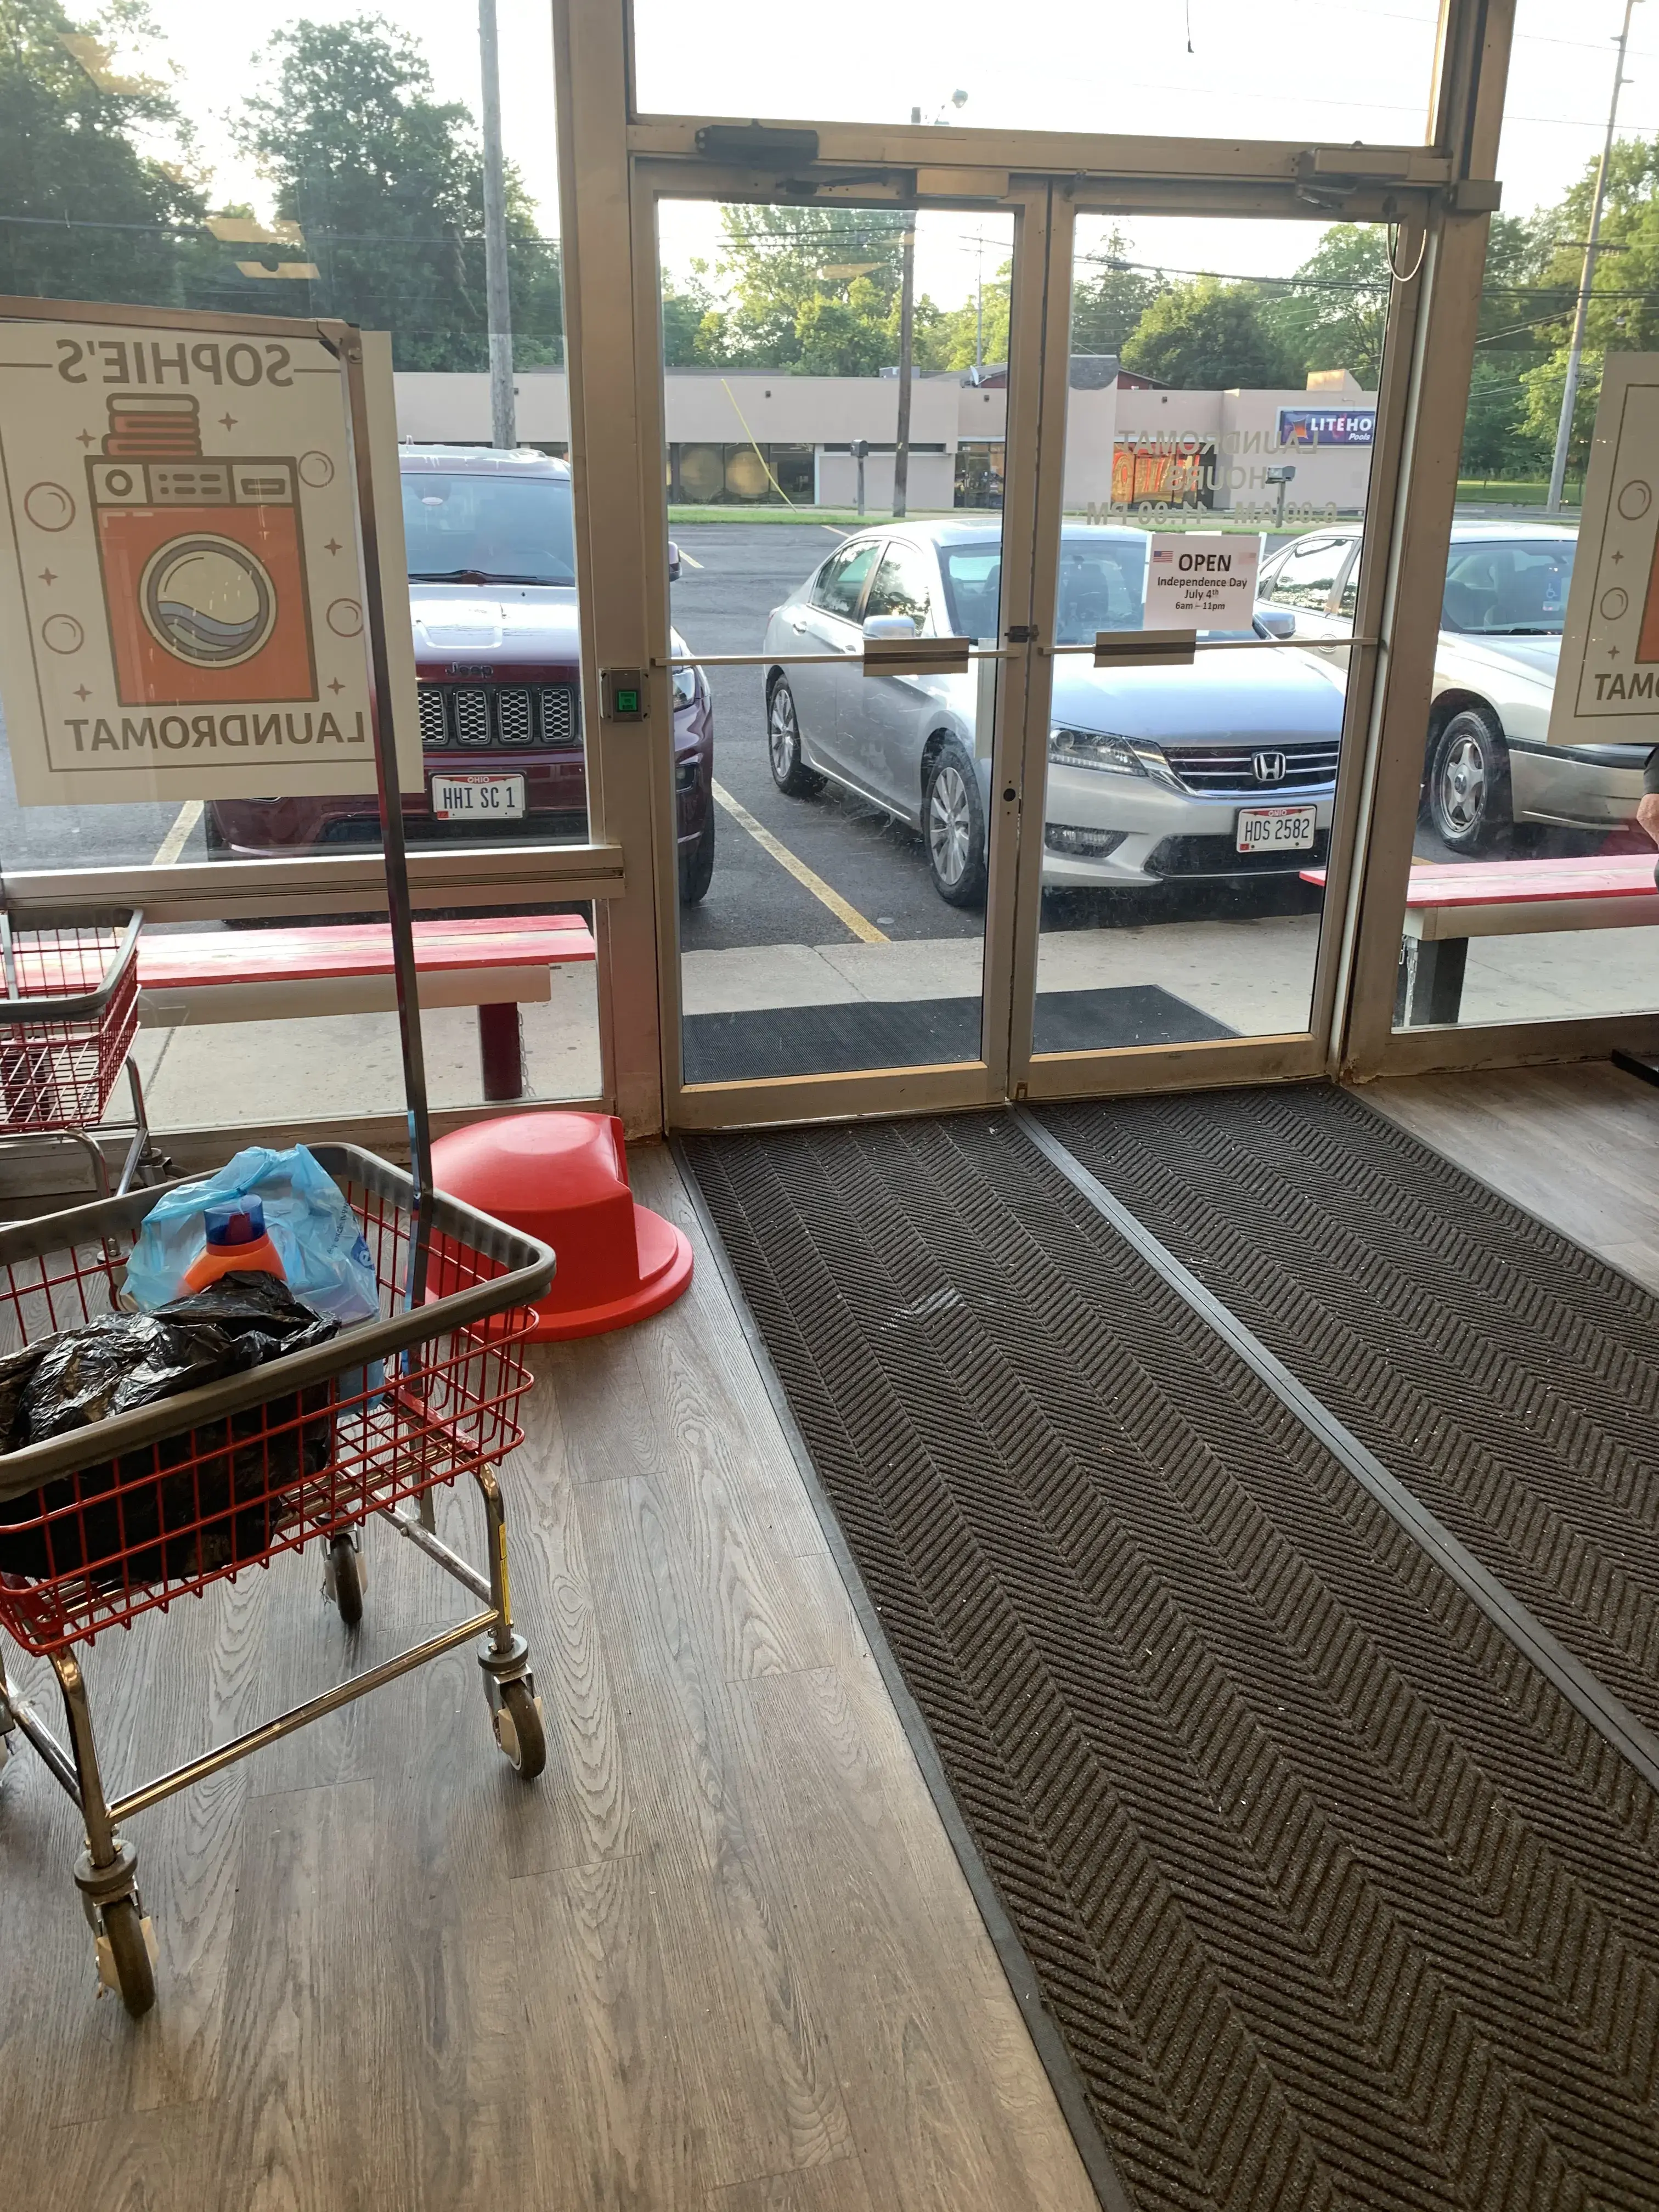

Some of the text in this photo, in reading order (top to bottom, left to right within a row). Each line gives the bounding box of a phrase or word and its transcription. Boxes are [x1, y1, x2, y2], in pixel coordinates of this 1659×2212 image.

[1311, 417, 1375, 431] LITEHO
[1178, 554, 1232, 572] OPEN
[1158, 577, 1248, 589] Independence Day
[1184, 589, 1219, 601] July 4th
[1203, 602, 1225, 611] 11pm
[445, 662, 493, 679] Jeep
[443, 787, 515, 809] HHI SC 1
[1245, 819, 1310, 842] HDS 2582
